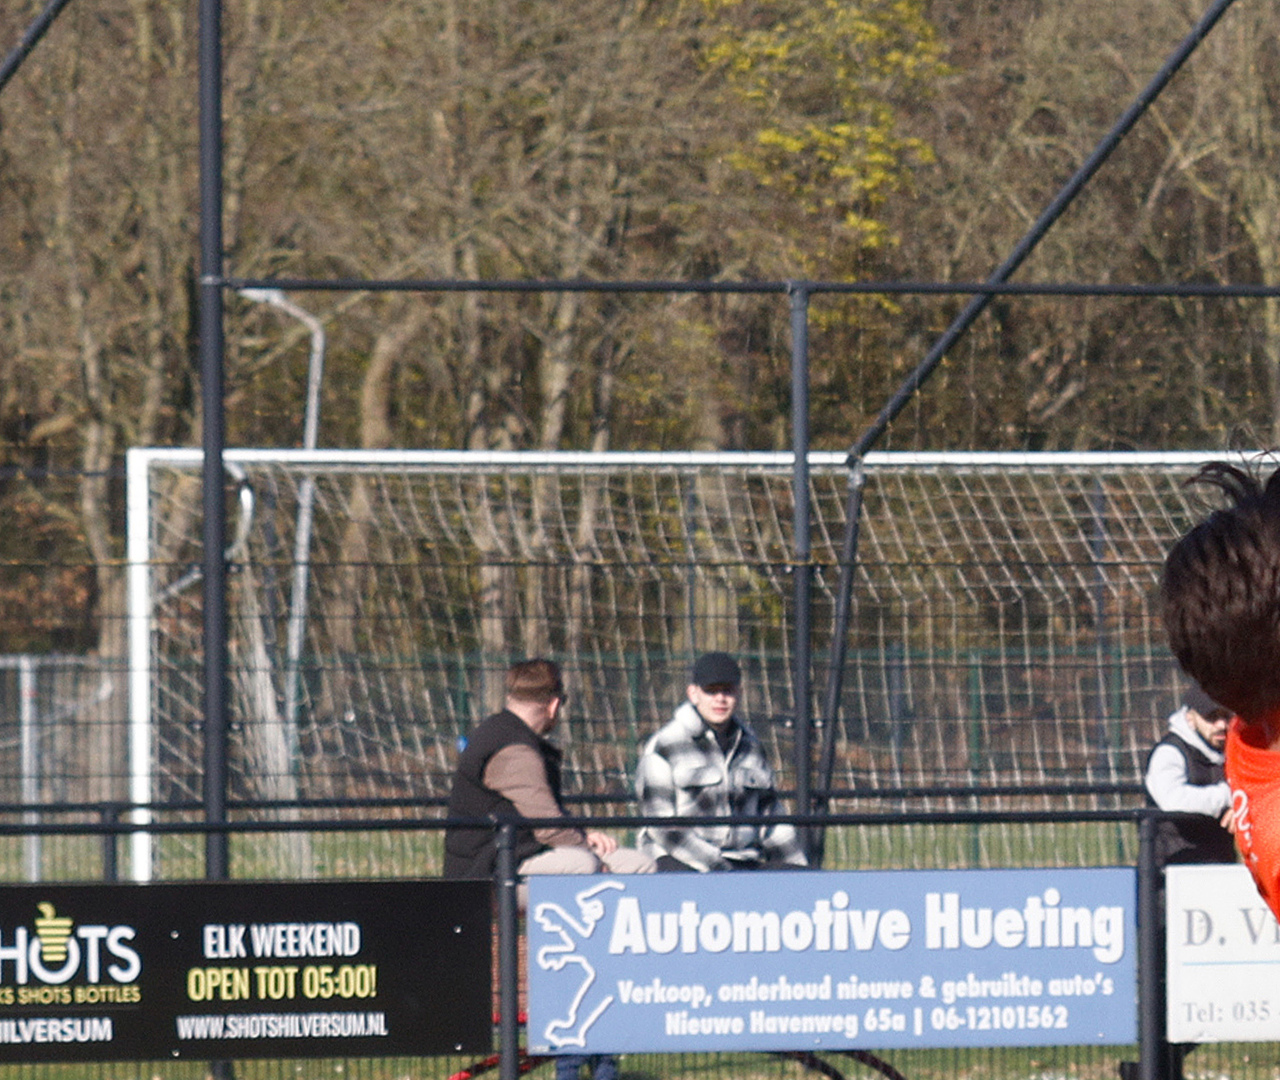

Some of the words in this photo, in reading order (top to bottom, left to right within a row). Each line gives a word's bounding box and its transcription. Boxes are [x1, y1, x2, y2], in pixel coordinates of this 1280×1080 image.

[203, 923, 247, 959] ELK
[250, 922, 361, 958] WEEKEND
[608, 891, 911, 954] Automotive
[925, 887, 1124, 963] Hueting
[1183, 908, 1226, 946] D.
[17, 986, 73, 1005] SHOTS
[74, 985, 142, 1004] BOTTLES
[187, 967, 250, 1001] OPEN
[253, 966, 299, 999] TOT
[302, 965, 377, 999] 05:00!
[617, 976, 713, 1009] Verkoop,
[718, 974, 832, 1001] onderhoud
[836, 974, 914, 1000] nieuwe
[919, 975, 936, 999] &
[941, 971, 1043, 1004] gebruikte
[1048, 971, 1114, 996] auto's
[176, 1012, 389, 1040] WWW.SHOTSHILVERSUM.NL
[665, 1010, 744, 1035] Nieuwe
[750, 1009, 858, 1039] Havenweg
[863, 1007, 906, 1032] 65a
[931, 1004, 1068, 1031] 06-12101562
[1183, 1002, 1224, 1023] Tel:
[1232, 1000, 1271, 1022] 035
